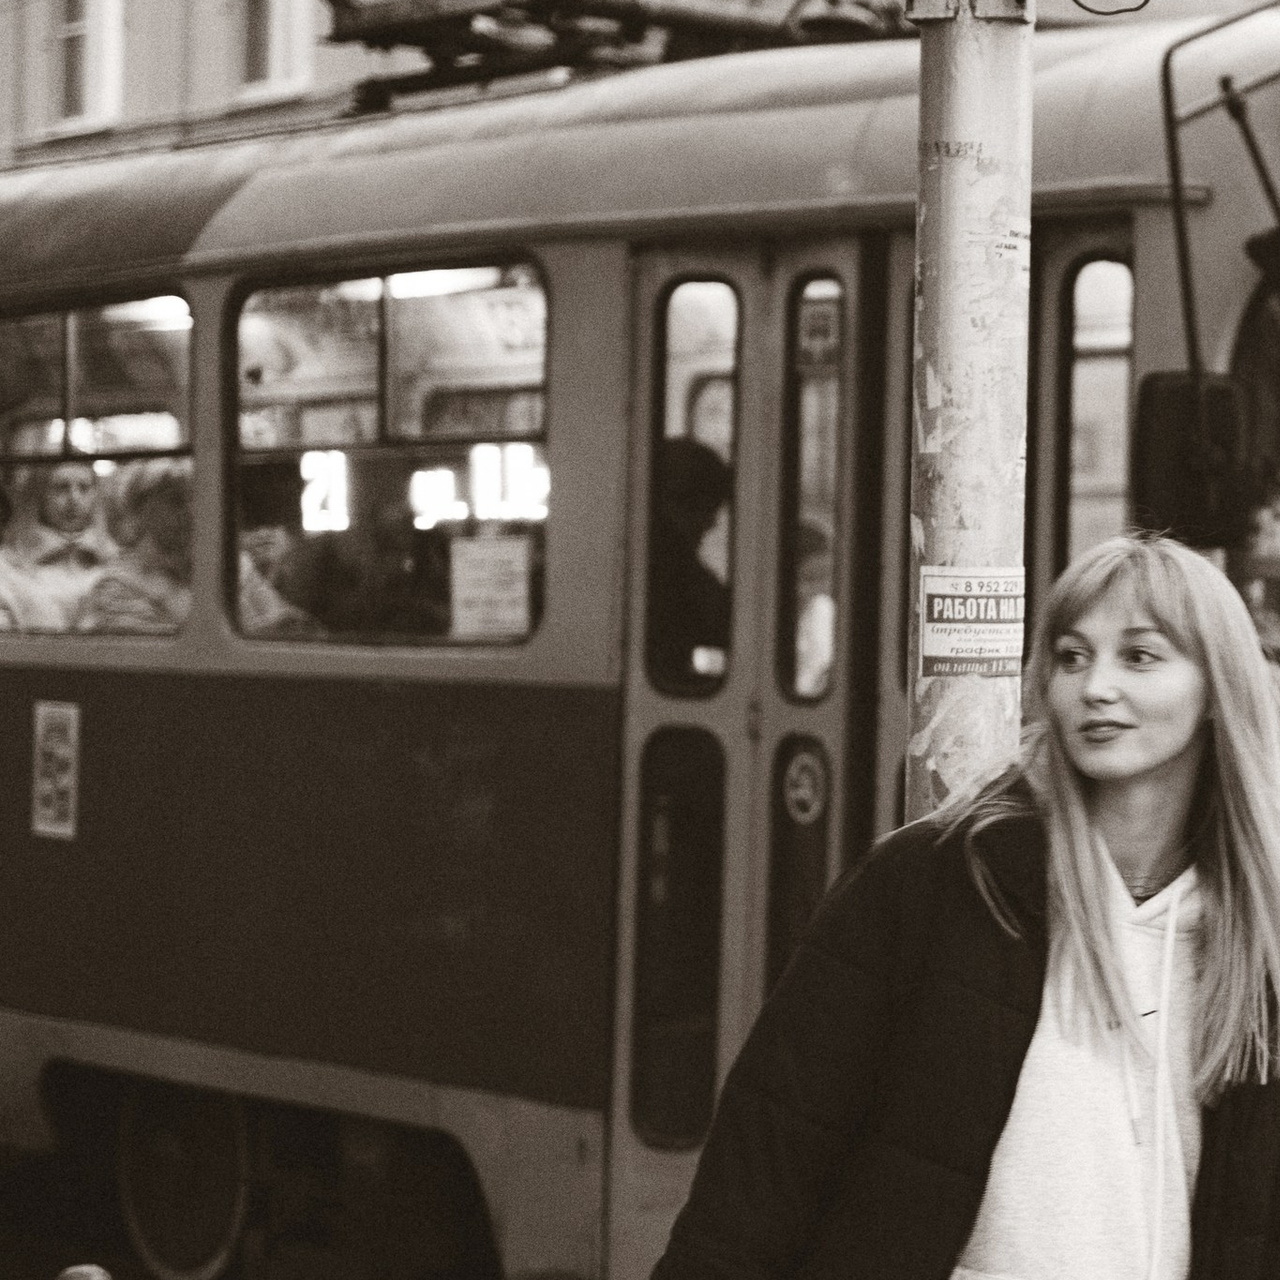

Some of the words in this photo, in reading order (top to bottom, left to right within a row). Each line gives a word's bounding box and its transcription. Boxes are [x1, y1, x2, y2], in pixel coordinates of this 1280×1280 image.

[964, 581, 972, 592] 8
[978, 581, 1000, 593] 952
[933, 597, 998, 619] РАБОТА
